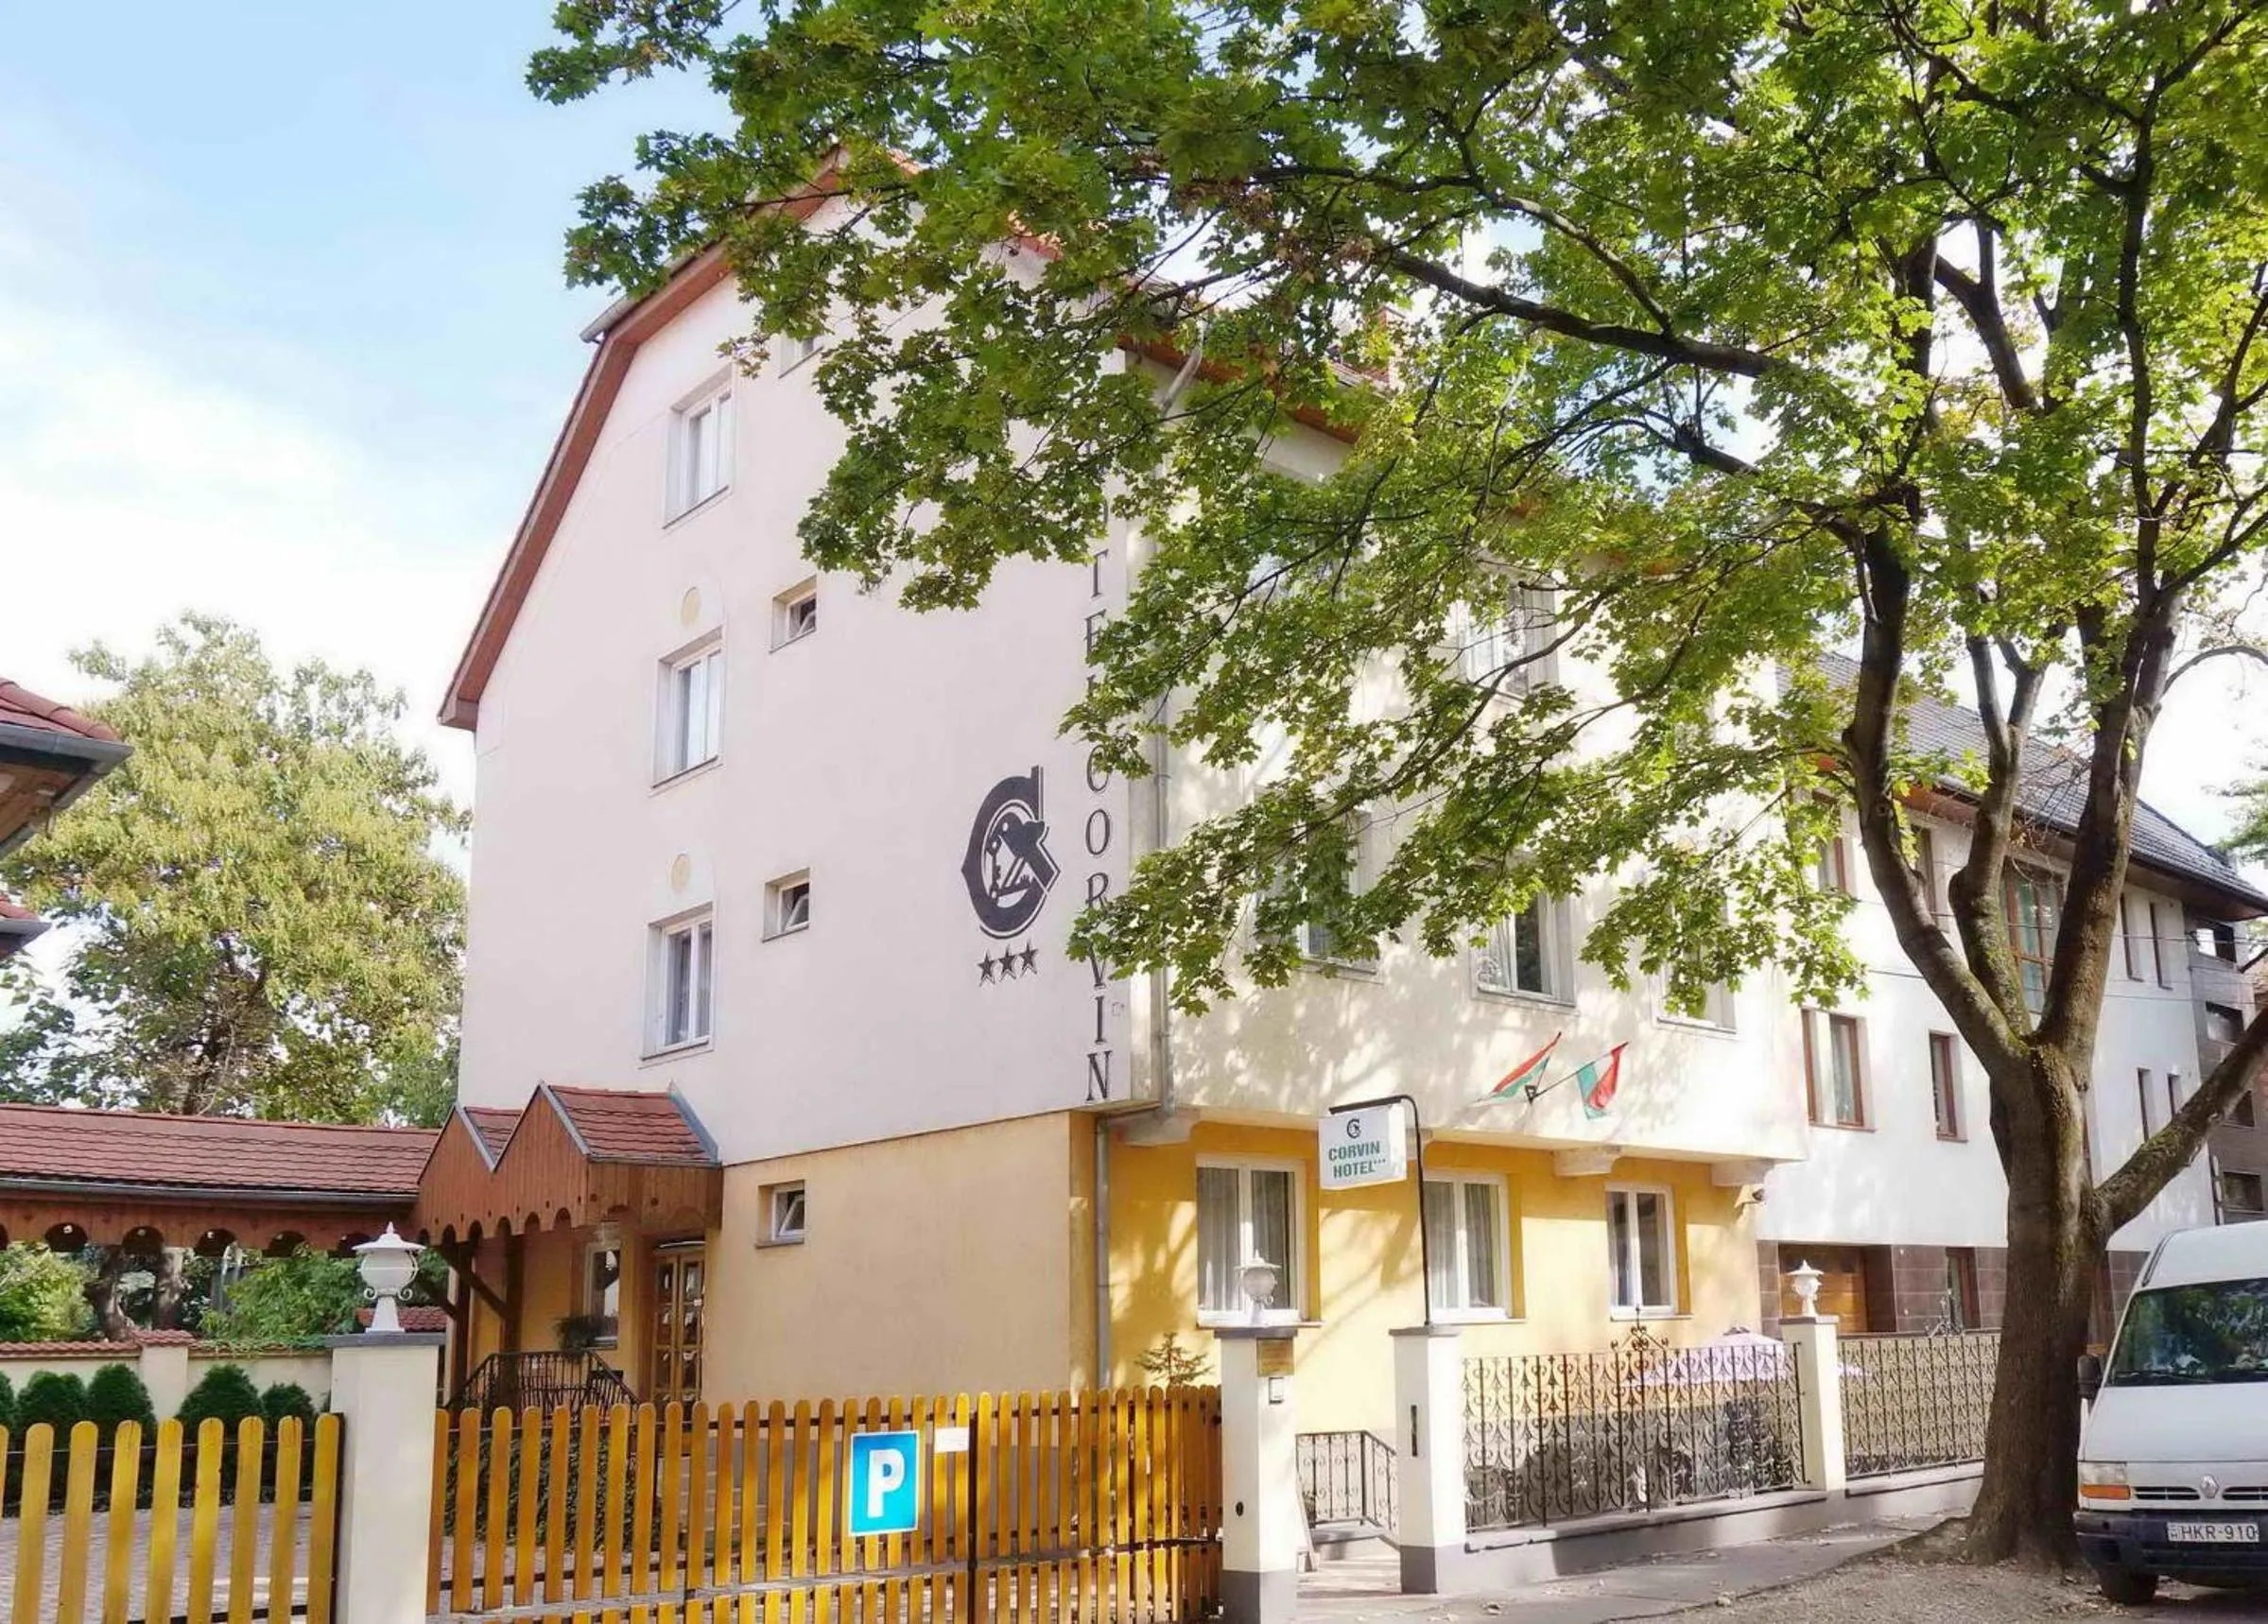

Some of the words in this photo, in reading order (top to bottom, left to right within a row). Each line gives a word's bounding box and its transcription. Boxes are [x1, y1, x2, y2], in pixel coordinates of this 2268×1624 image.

[1328, 1140, 1380, 1161] CORVIN
[1333, 1161, 1376, 1179] HOTEL
[867, 1448, 905, 1518] P
[2180, 1525, 2256, 1540] HKR-910
